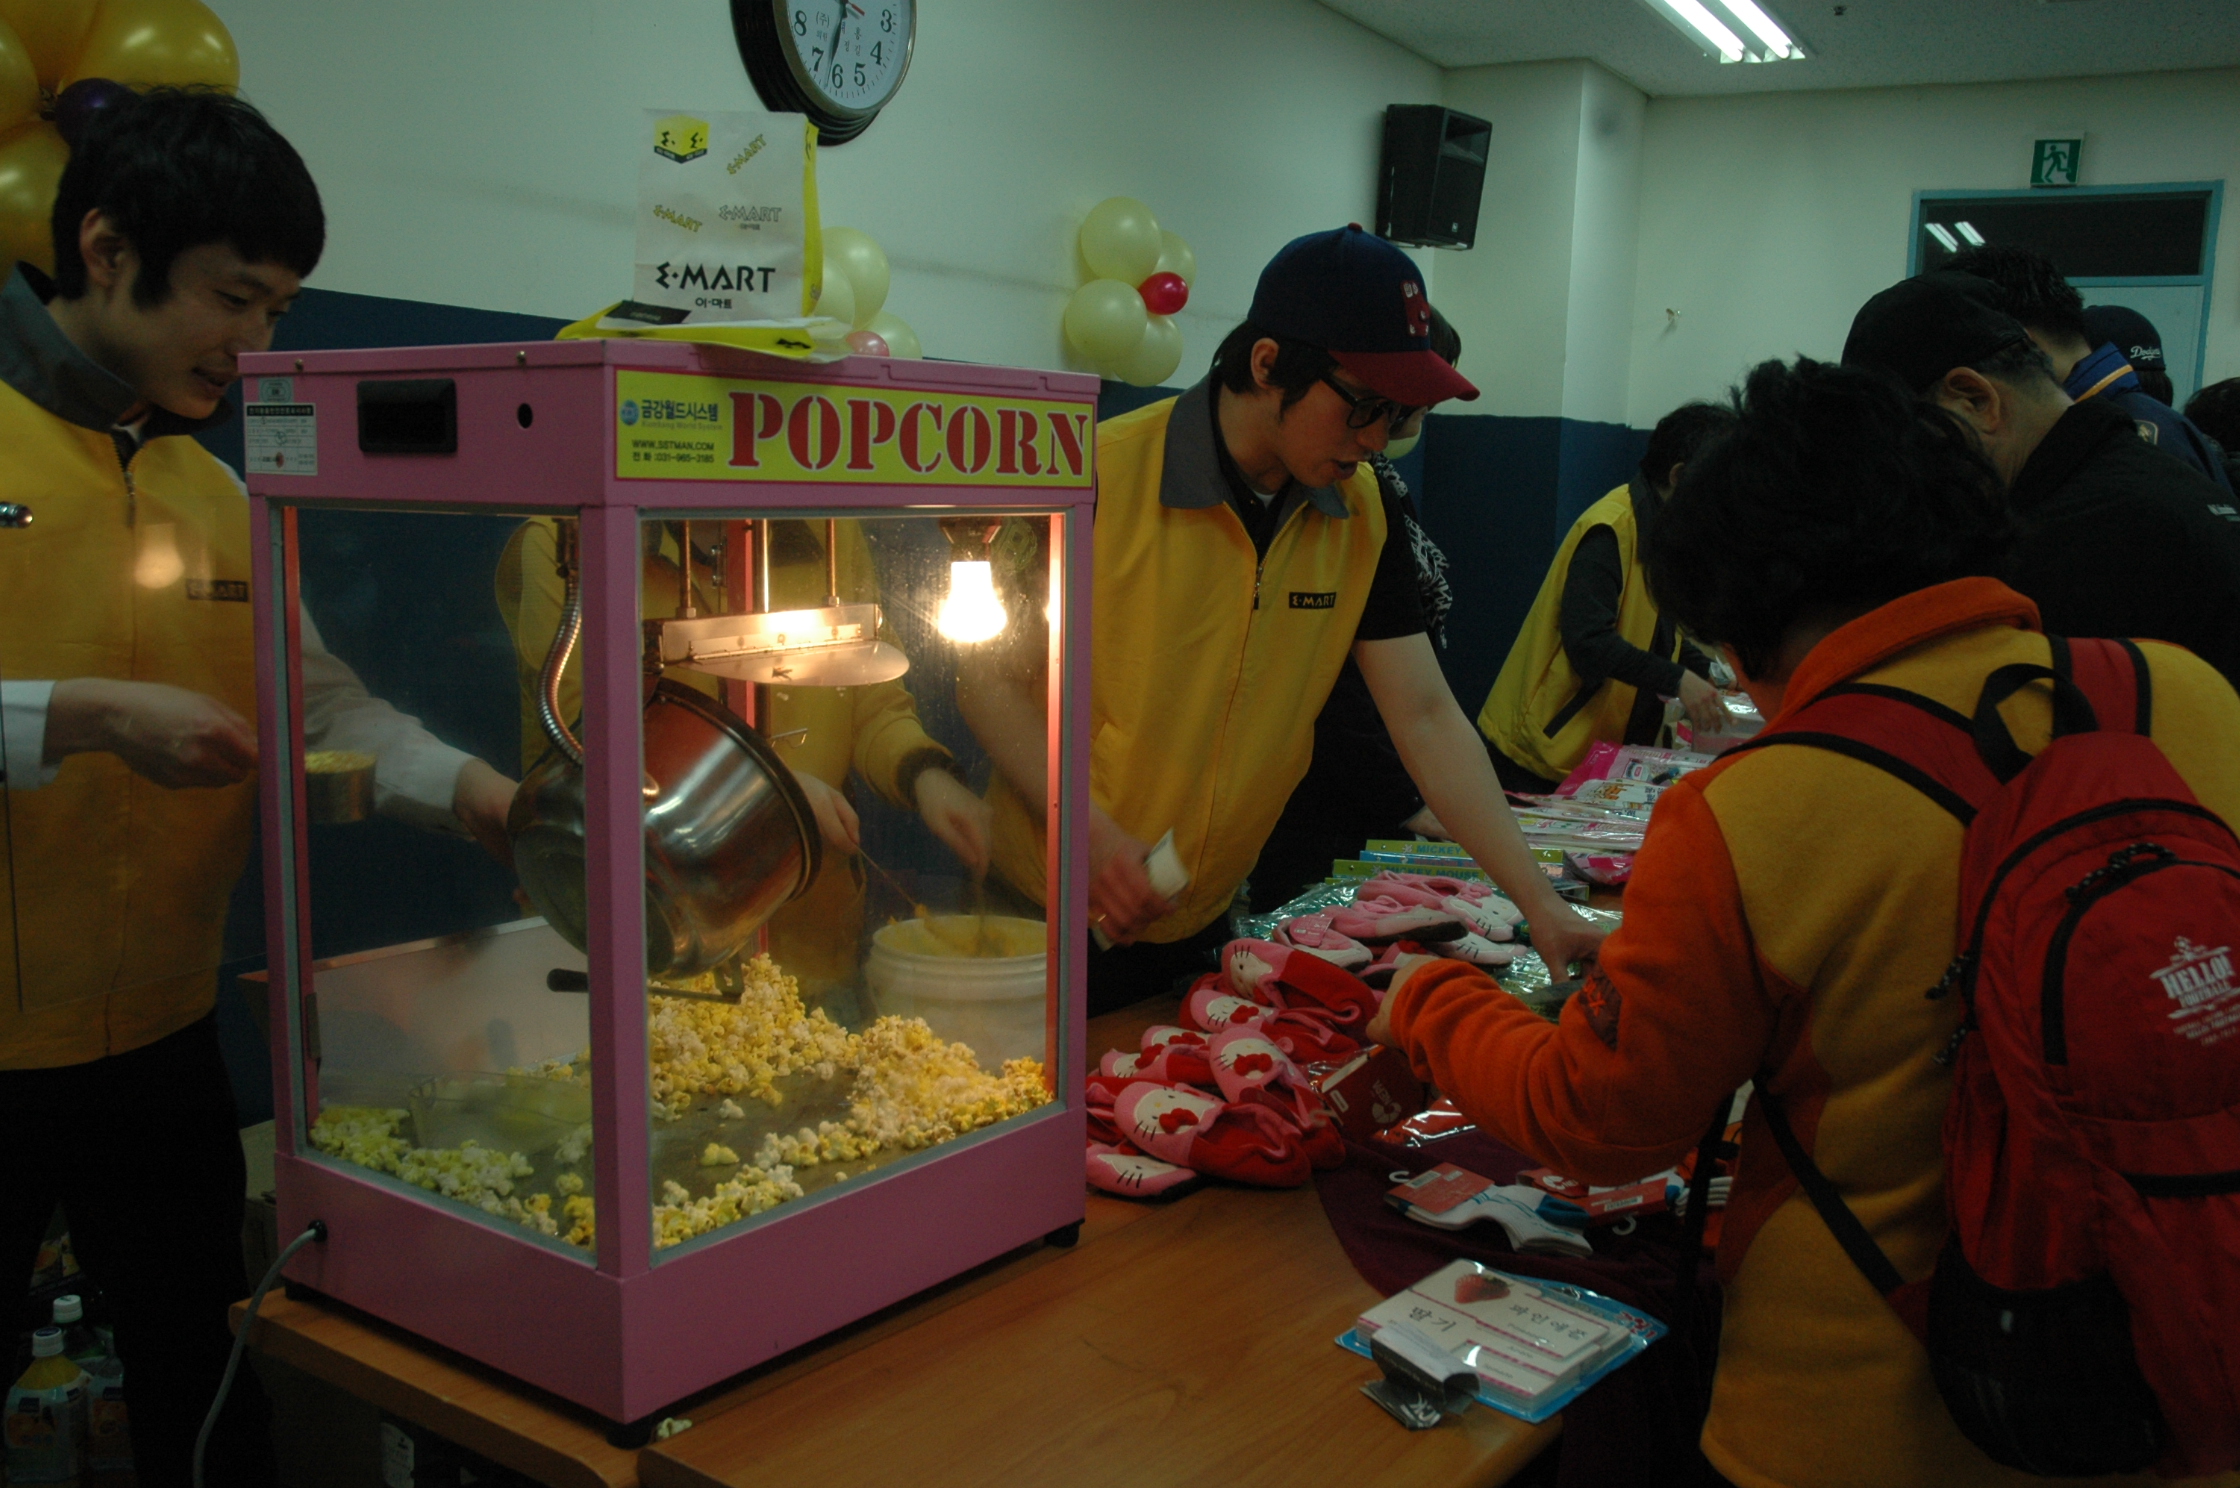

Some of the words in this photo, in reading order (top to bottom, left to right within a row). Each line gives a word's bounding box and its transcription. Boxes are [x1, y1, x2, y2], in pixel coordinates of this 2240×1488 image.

[794, 10, 807, 36] 8
[880, 9, 892, 33] 3
[812, 46, 824, 72] 7
[870, 40, 882, 65] 4
[832, 63, 843, 89] 6
[854, 62, 866, 87] 5
[641, 399, 718, 422] 금강월드시스템
[632, 440, 715, 451] WWW.SSTMAN.COM
[727, 391, 1089, 477] POPCORN
[1416, 844, 1462, 855] MICKEY
[1437, 868, 1479, 880] MOUSE
[2161, 955, 2235, 999] HELLO!
[1409, 1306, 1457, 1332] 딸기
